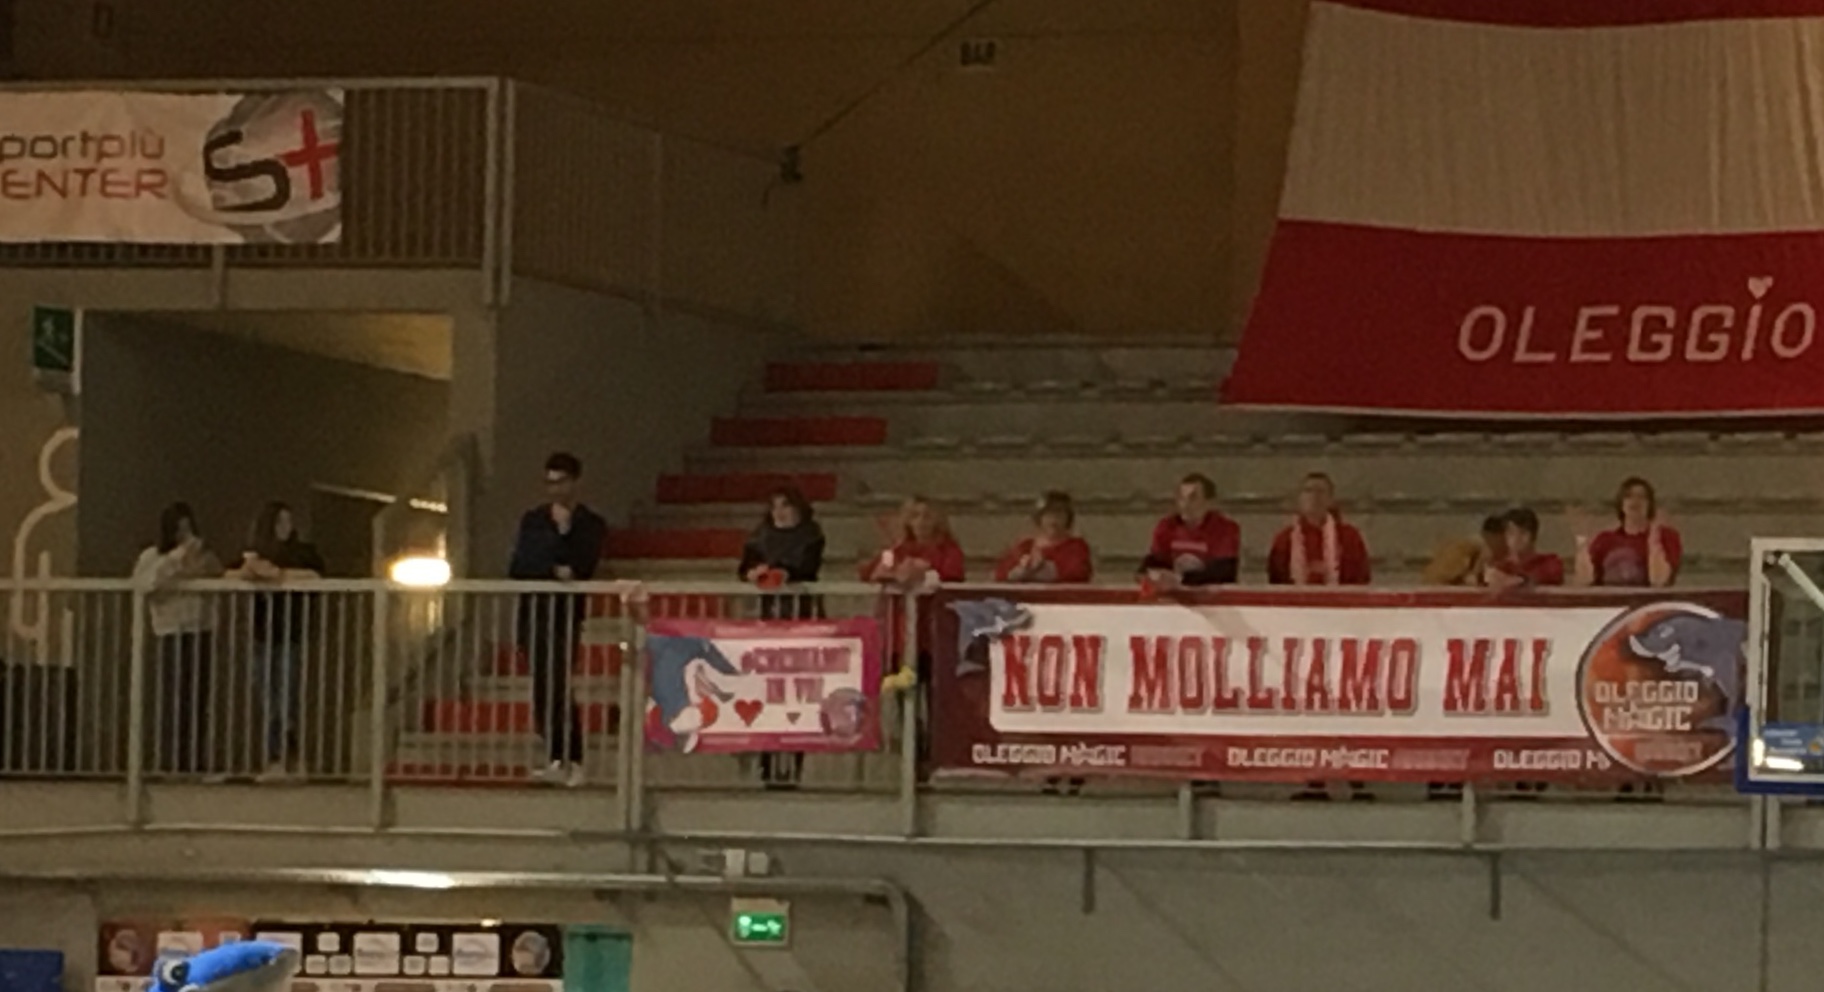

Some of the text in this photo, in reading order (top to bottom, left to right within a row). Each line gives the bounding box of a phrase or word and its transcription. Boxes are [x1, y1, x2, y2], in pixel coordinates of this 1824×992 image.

[1002, 634, 1551, 717] NON MOLLIAMO MAI
[1595, 681, 1699, 703] OLEGGIO
[972, 744, 1056, 764] OLEGGIO
[1227, 746, 1315, 768] OLEGGIO
[1493, 749, 1581, 770] OLEGGIO
